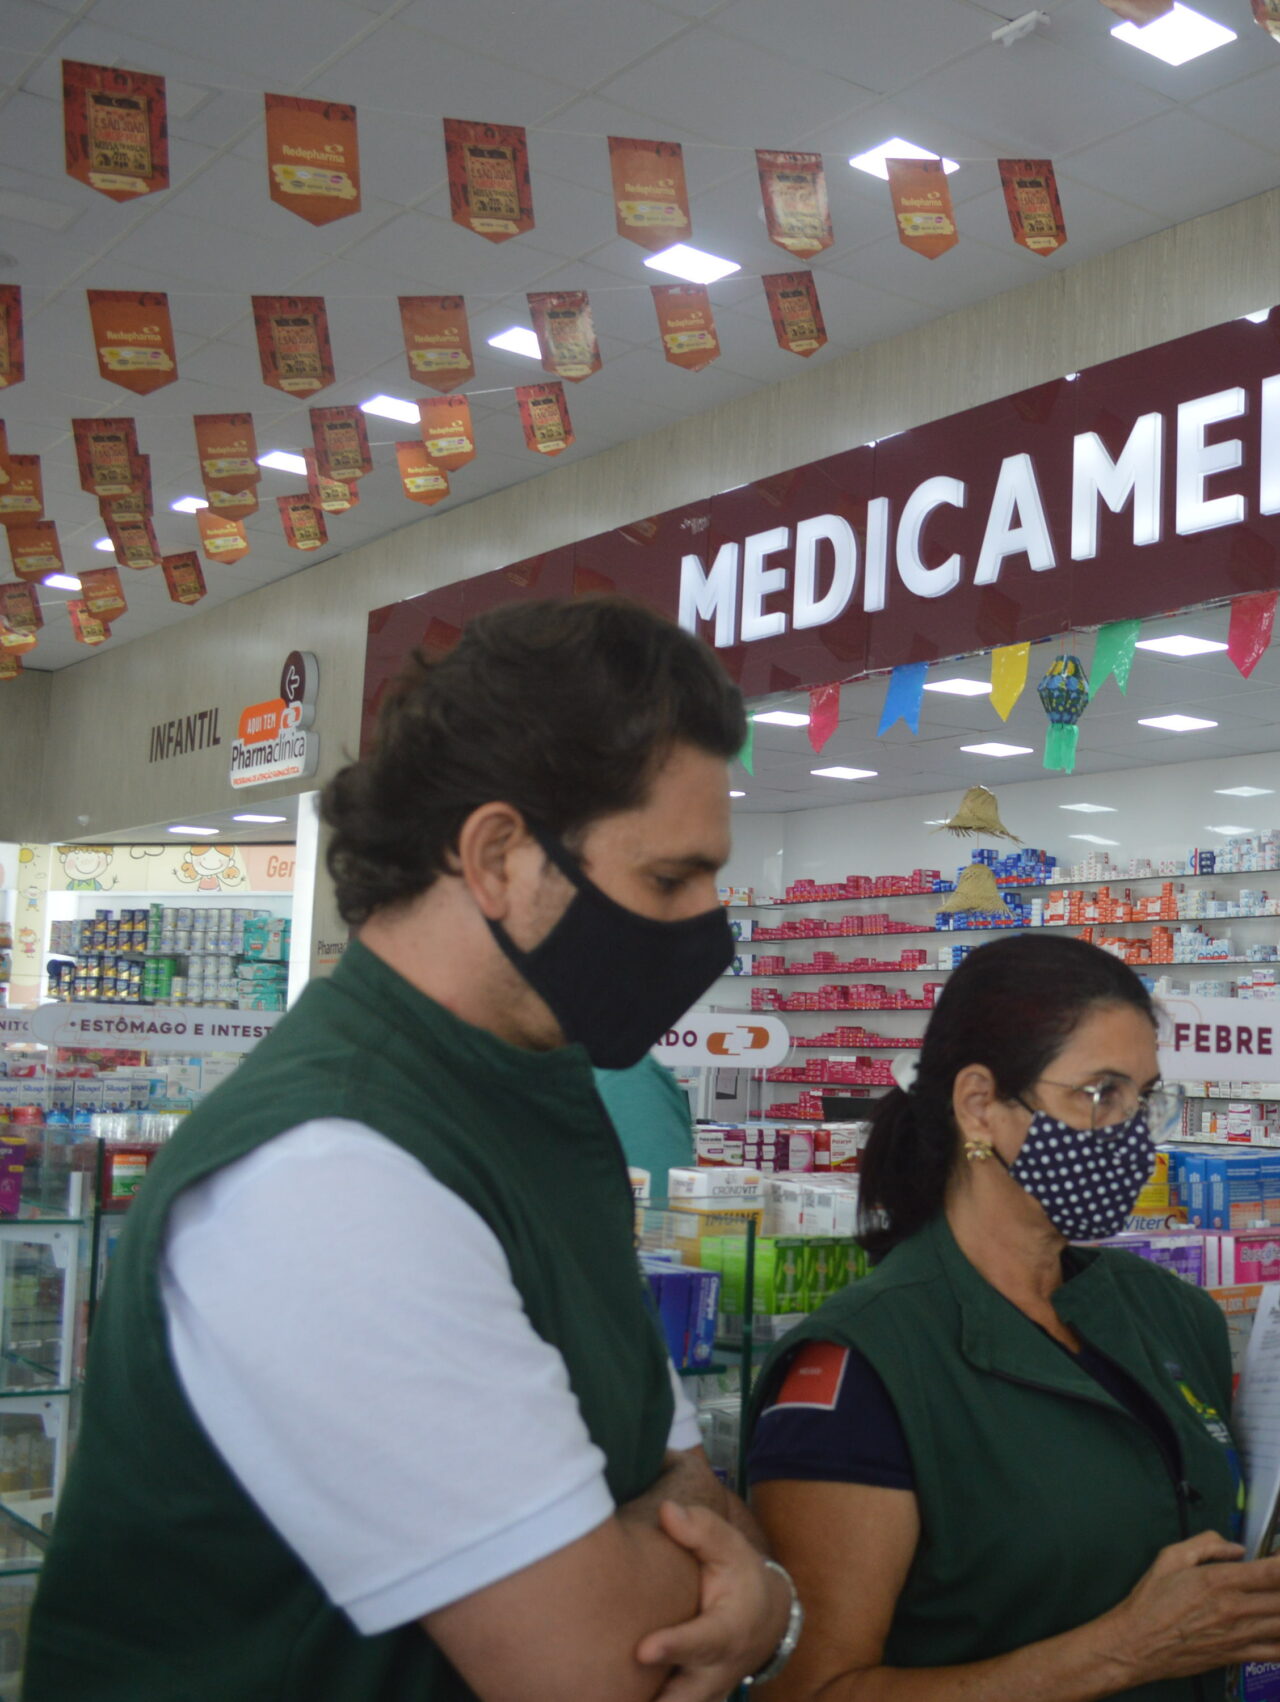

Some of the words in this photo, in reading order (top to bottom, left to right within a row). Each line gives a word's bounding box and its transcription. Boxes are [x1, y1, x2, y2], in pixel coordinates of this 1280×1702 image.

[282, 144, 345, 164] Redepharma
[149, 708, 221, 764] INFANTIL
[247, 716, 262, 735] AQUI
[231, 732, 305, 771] Pharmaclínica
[81, 1017, 188, 1036] ESTÔMAGO
[195, 1023, 205, 1036] E
[1174, 1023, 1273, 1056] FEBRE
